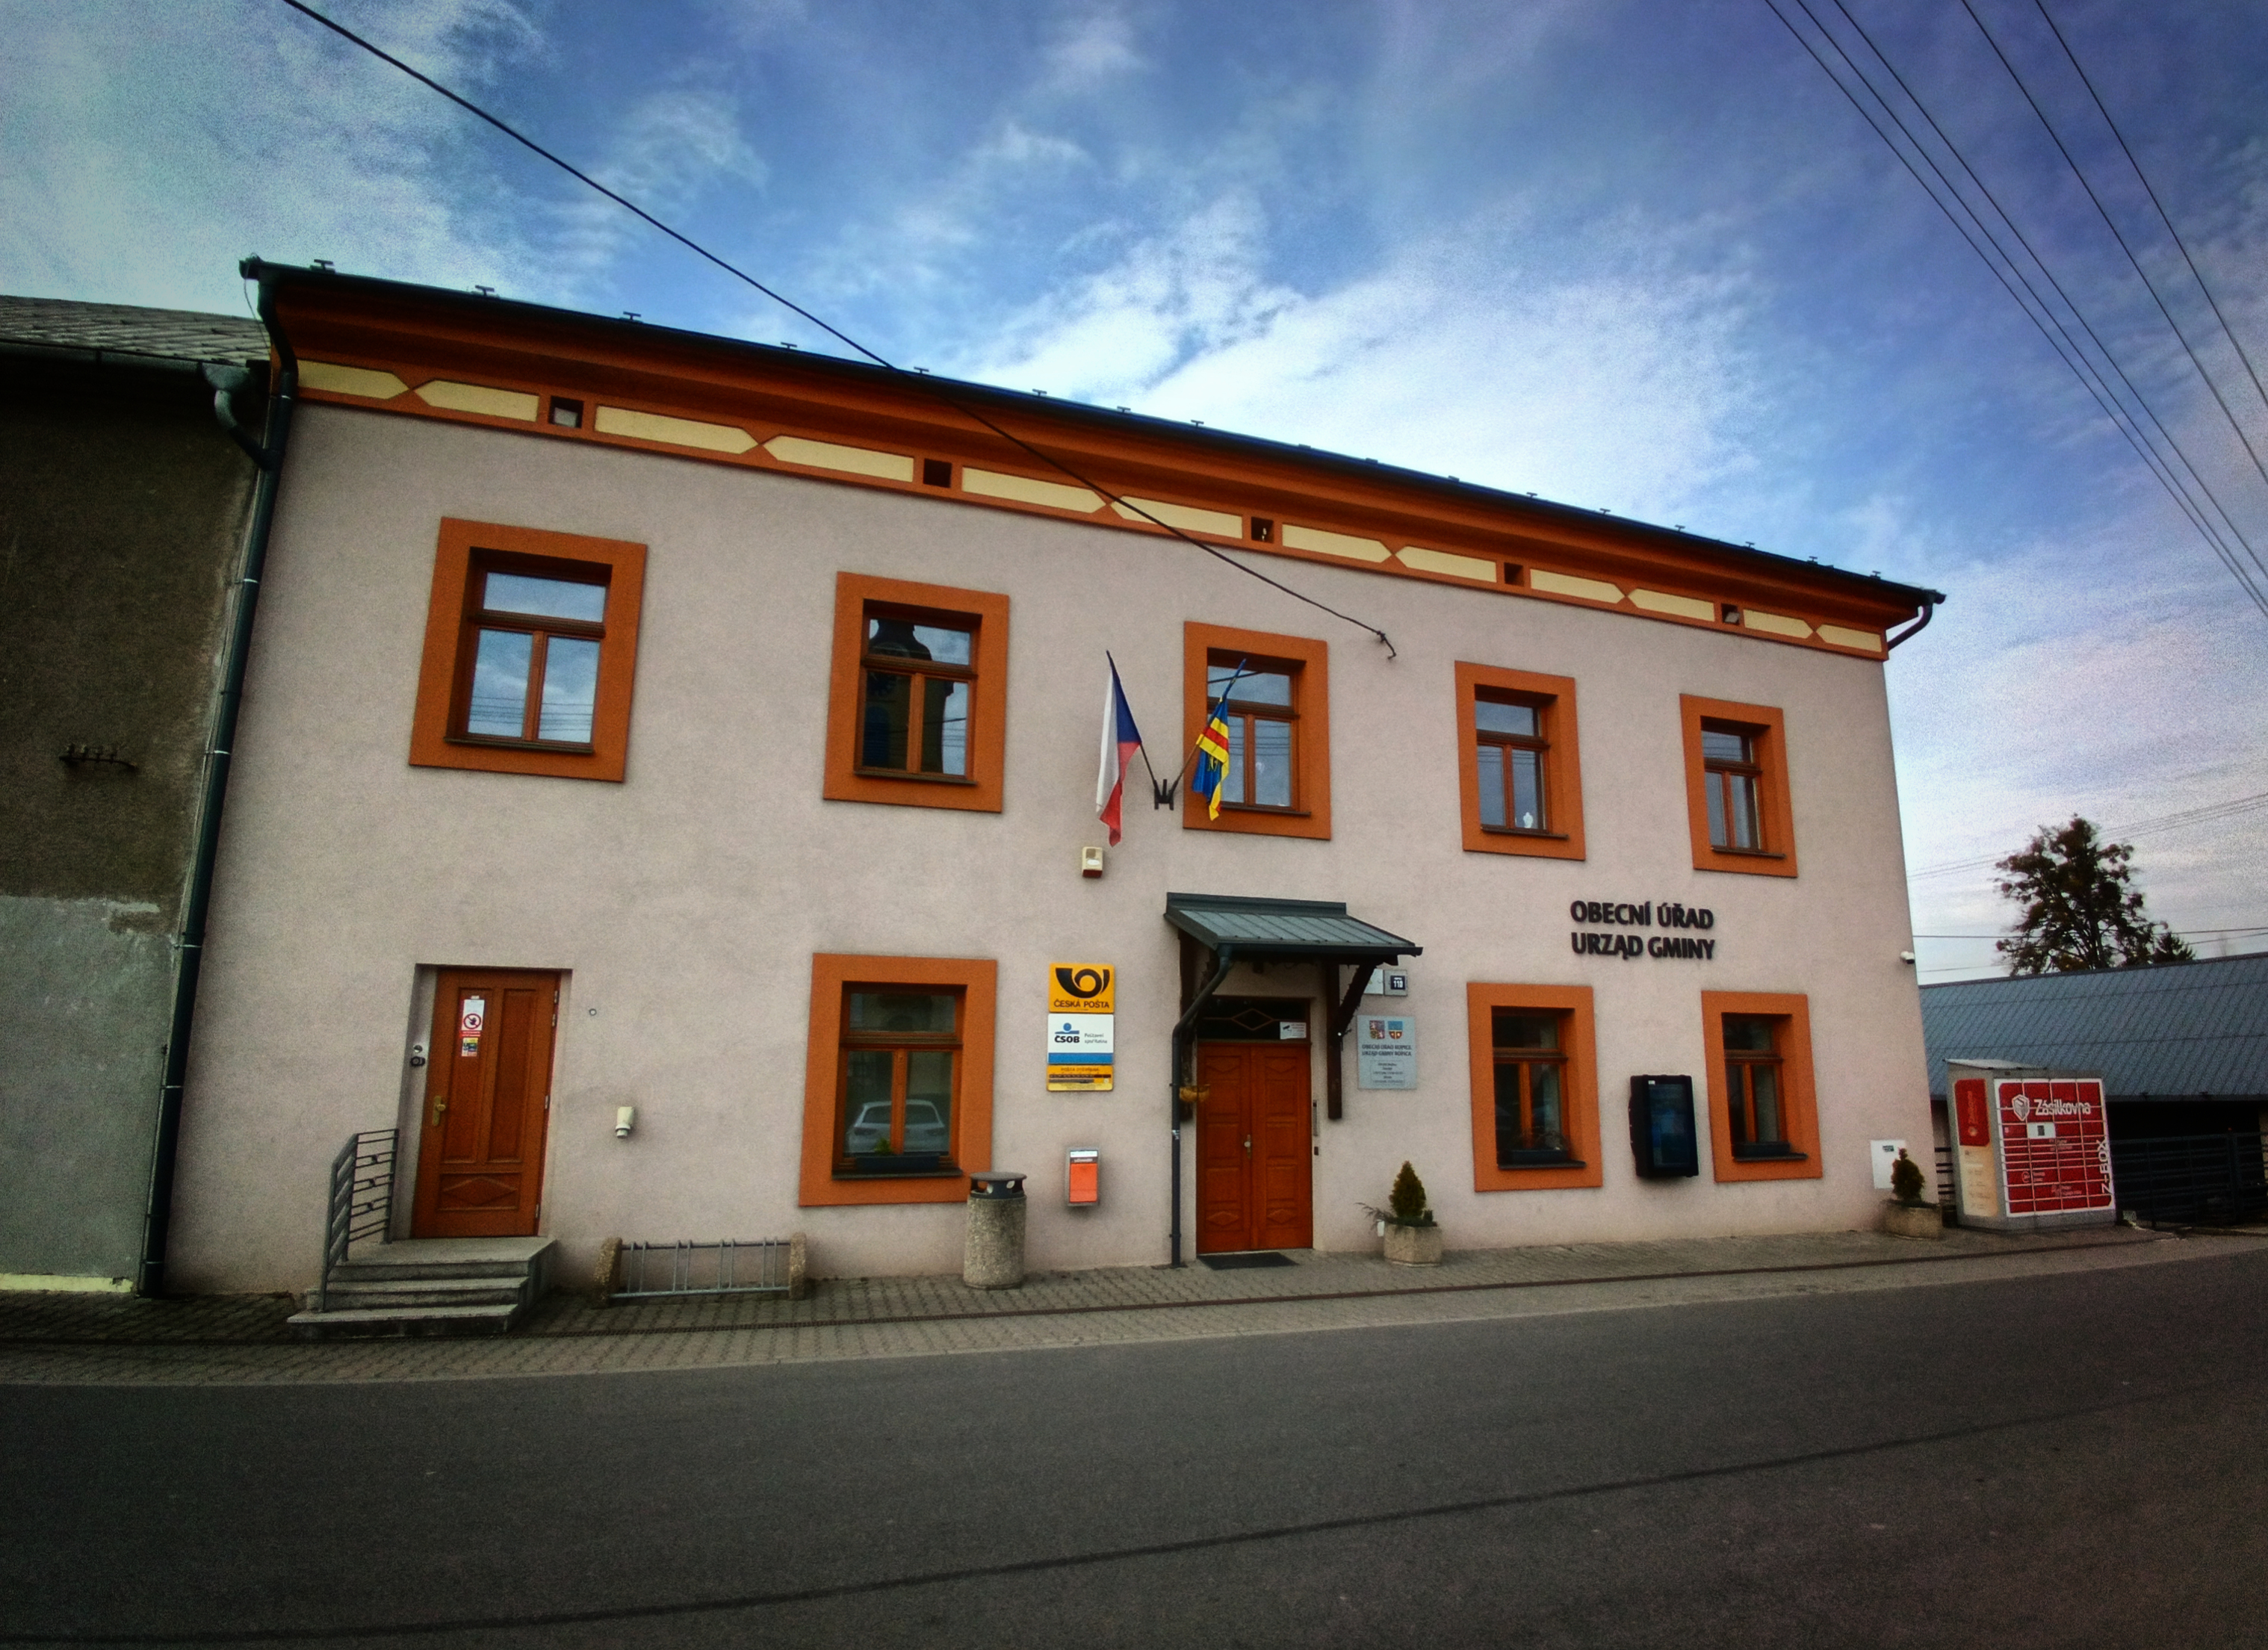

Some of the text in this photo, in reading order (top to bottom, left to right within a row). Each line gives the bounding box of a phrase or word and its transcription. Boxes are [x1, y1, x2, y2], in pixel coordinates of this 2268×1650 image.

[1570, 900, 1714, 928] OBECNÍ ÚŘAD
[1571, 932, 1715, 960] URZĄD GMINY
[1053, 999, 1109, 1008] ČESKÁ POŠTA
[1054, 1035, 1080, 1043] ČSOB
[2033, 1098, 2091, 1116] Zásilkovna
[2096, 1139, 2113, 1194] Z-BOX
